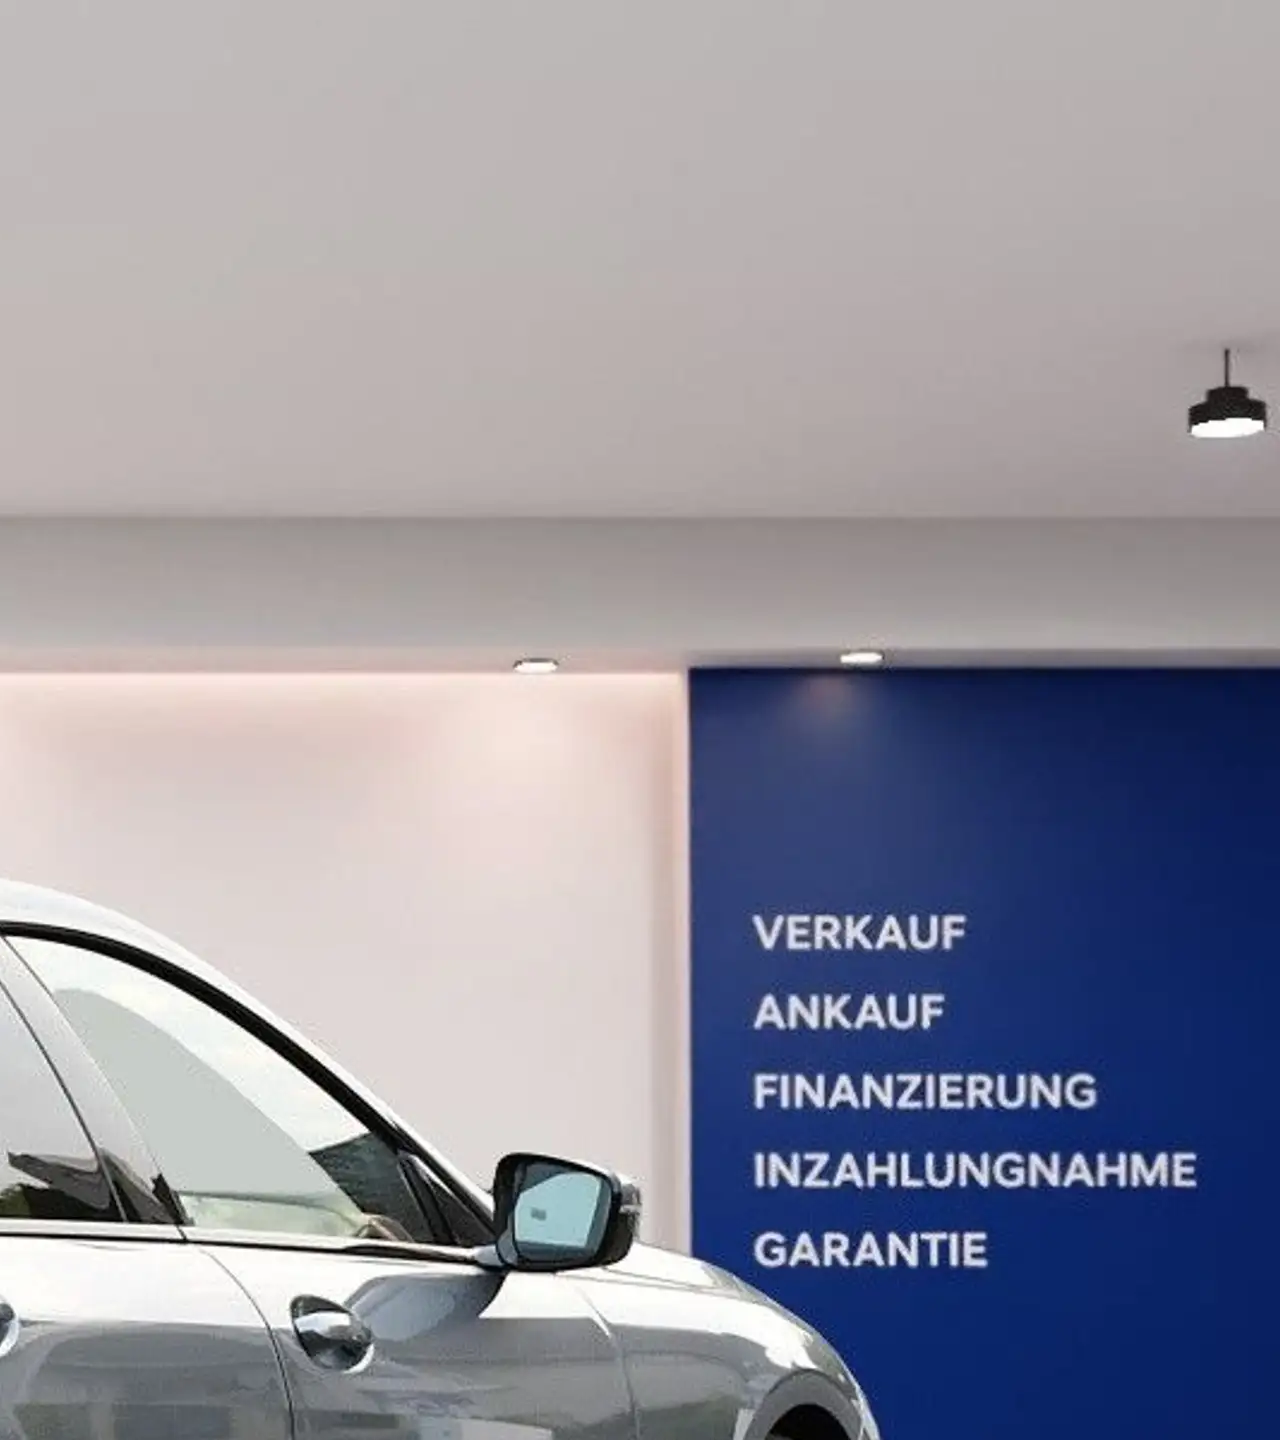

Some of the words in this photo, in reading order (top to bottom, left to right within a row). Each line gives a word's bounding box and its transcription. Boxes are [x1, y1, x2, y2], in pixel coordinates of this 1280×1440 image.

[753, 914, 966, 950] VERKAUF
[753, 994, 945, 1029] ANKAUF
[754, 1073, 1097, 1109] FINANZIERUNG
[754, 1152, 1197, 1188] INZAHLUNGNAHME
[753, 1231, 988, 1268] GARANTIE
